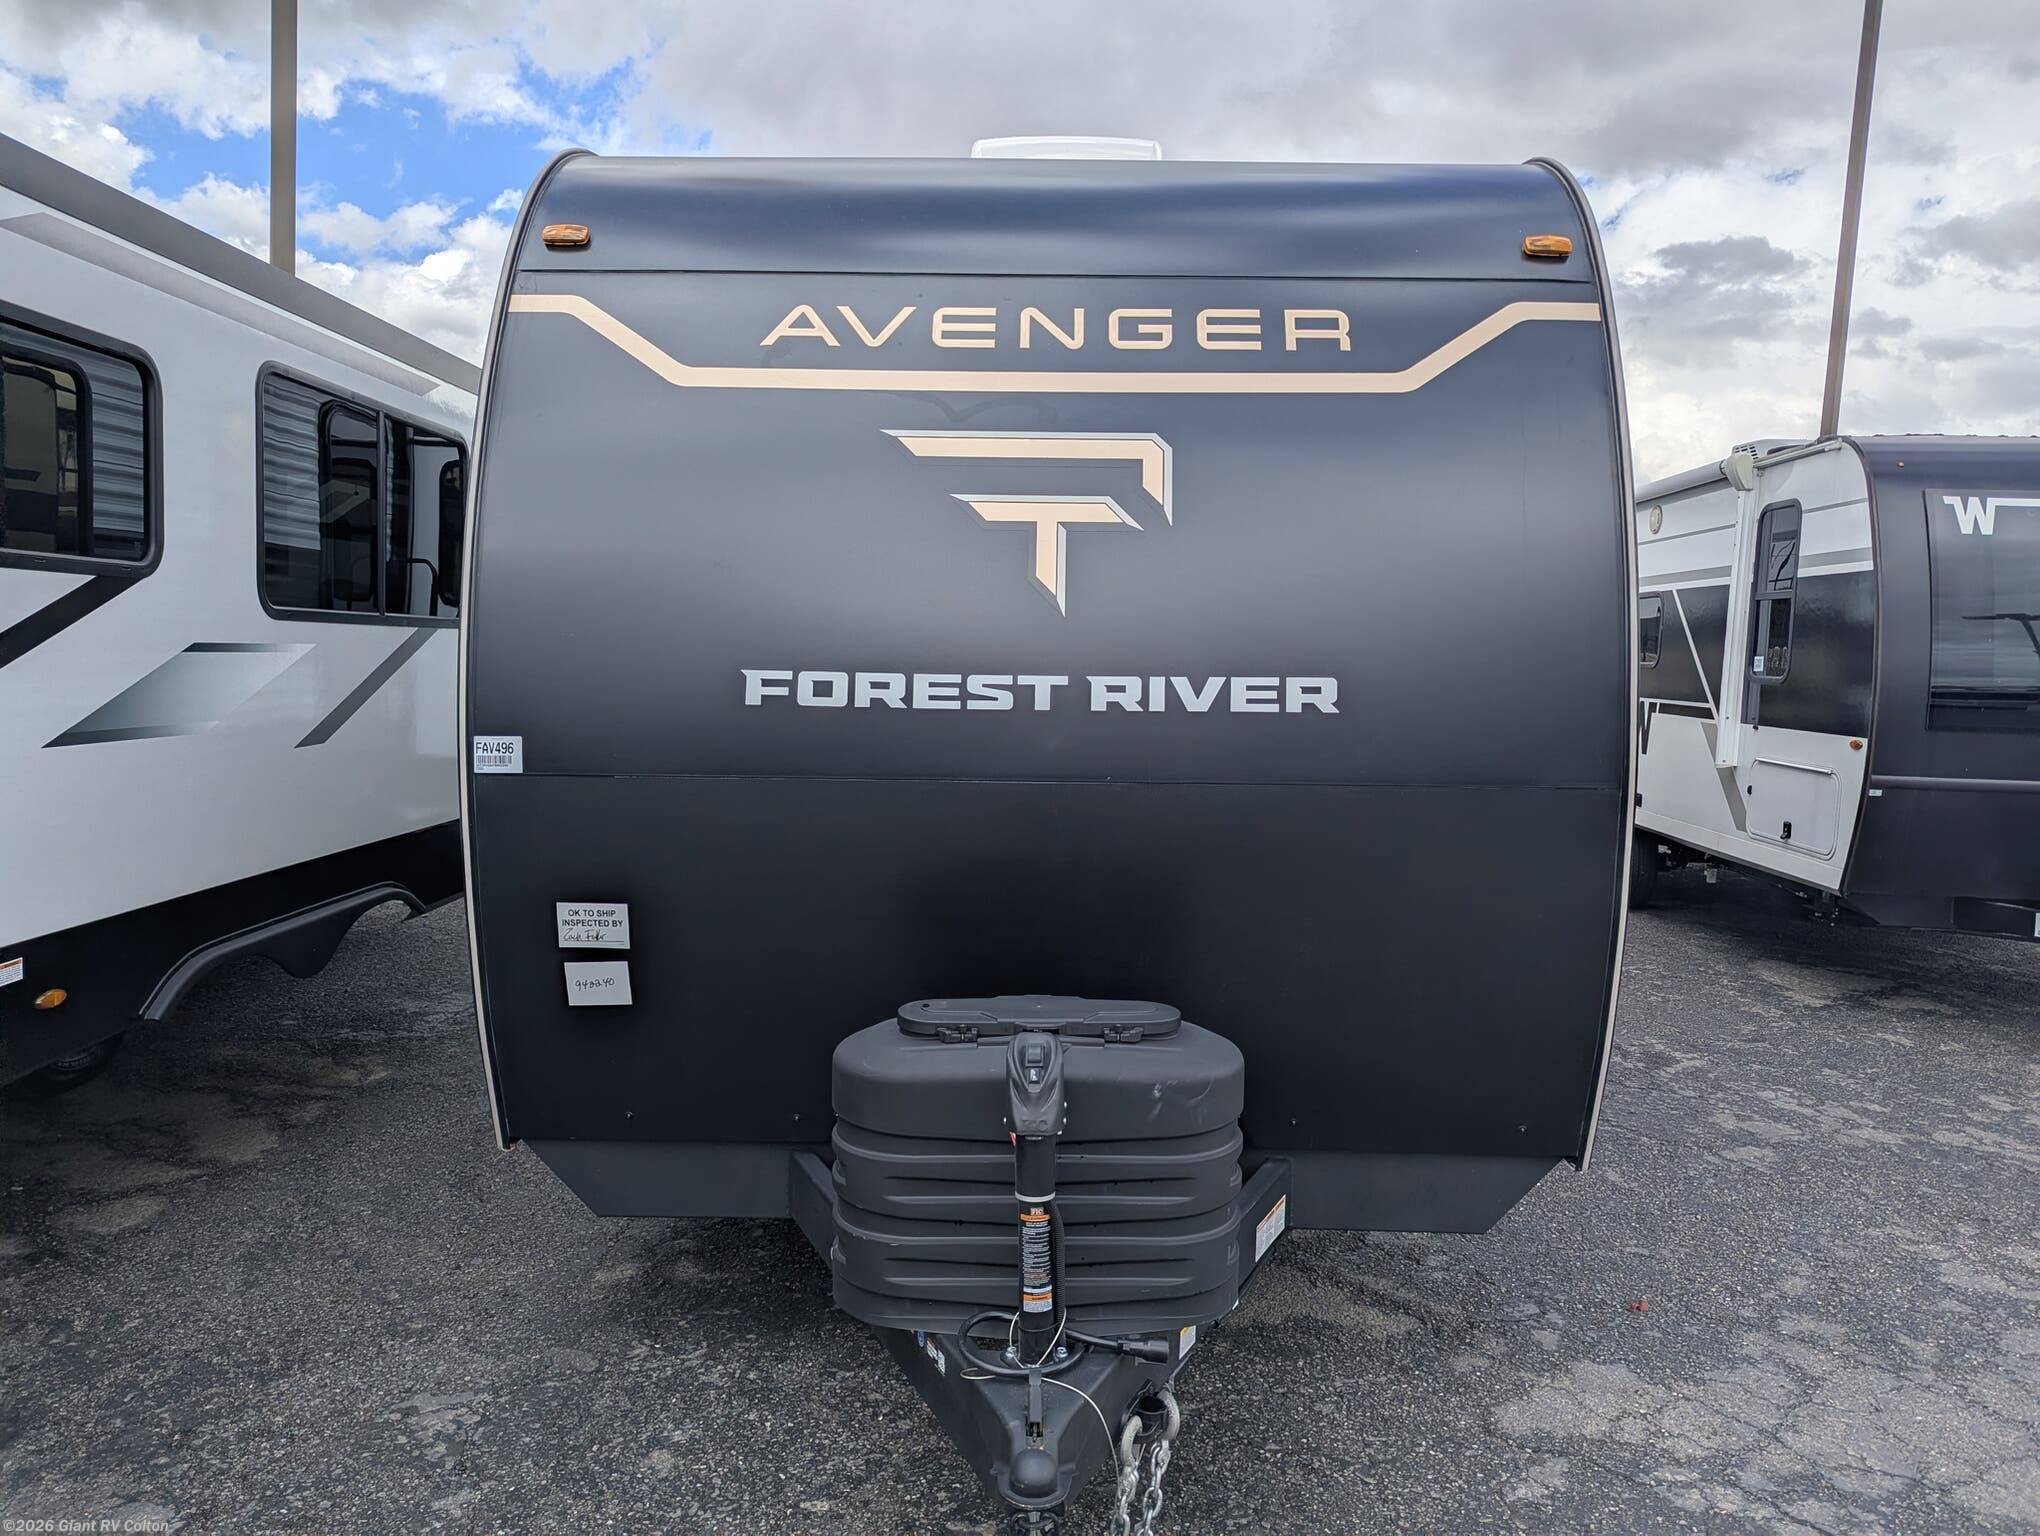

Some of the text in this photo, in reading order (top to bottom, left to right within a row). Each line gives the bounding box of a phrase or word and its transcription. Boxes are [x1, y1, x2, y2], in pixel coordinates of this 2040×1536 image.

[760, 304, 1351, 352] AVENGER
[740, 669, 1340, 714] FOREST RIVER
[475, 741, 514, 755] FAV496
[567, 908, 616, 918] OK TO SHIP
[561, 918, 624, 928] INSPECTED BY
